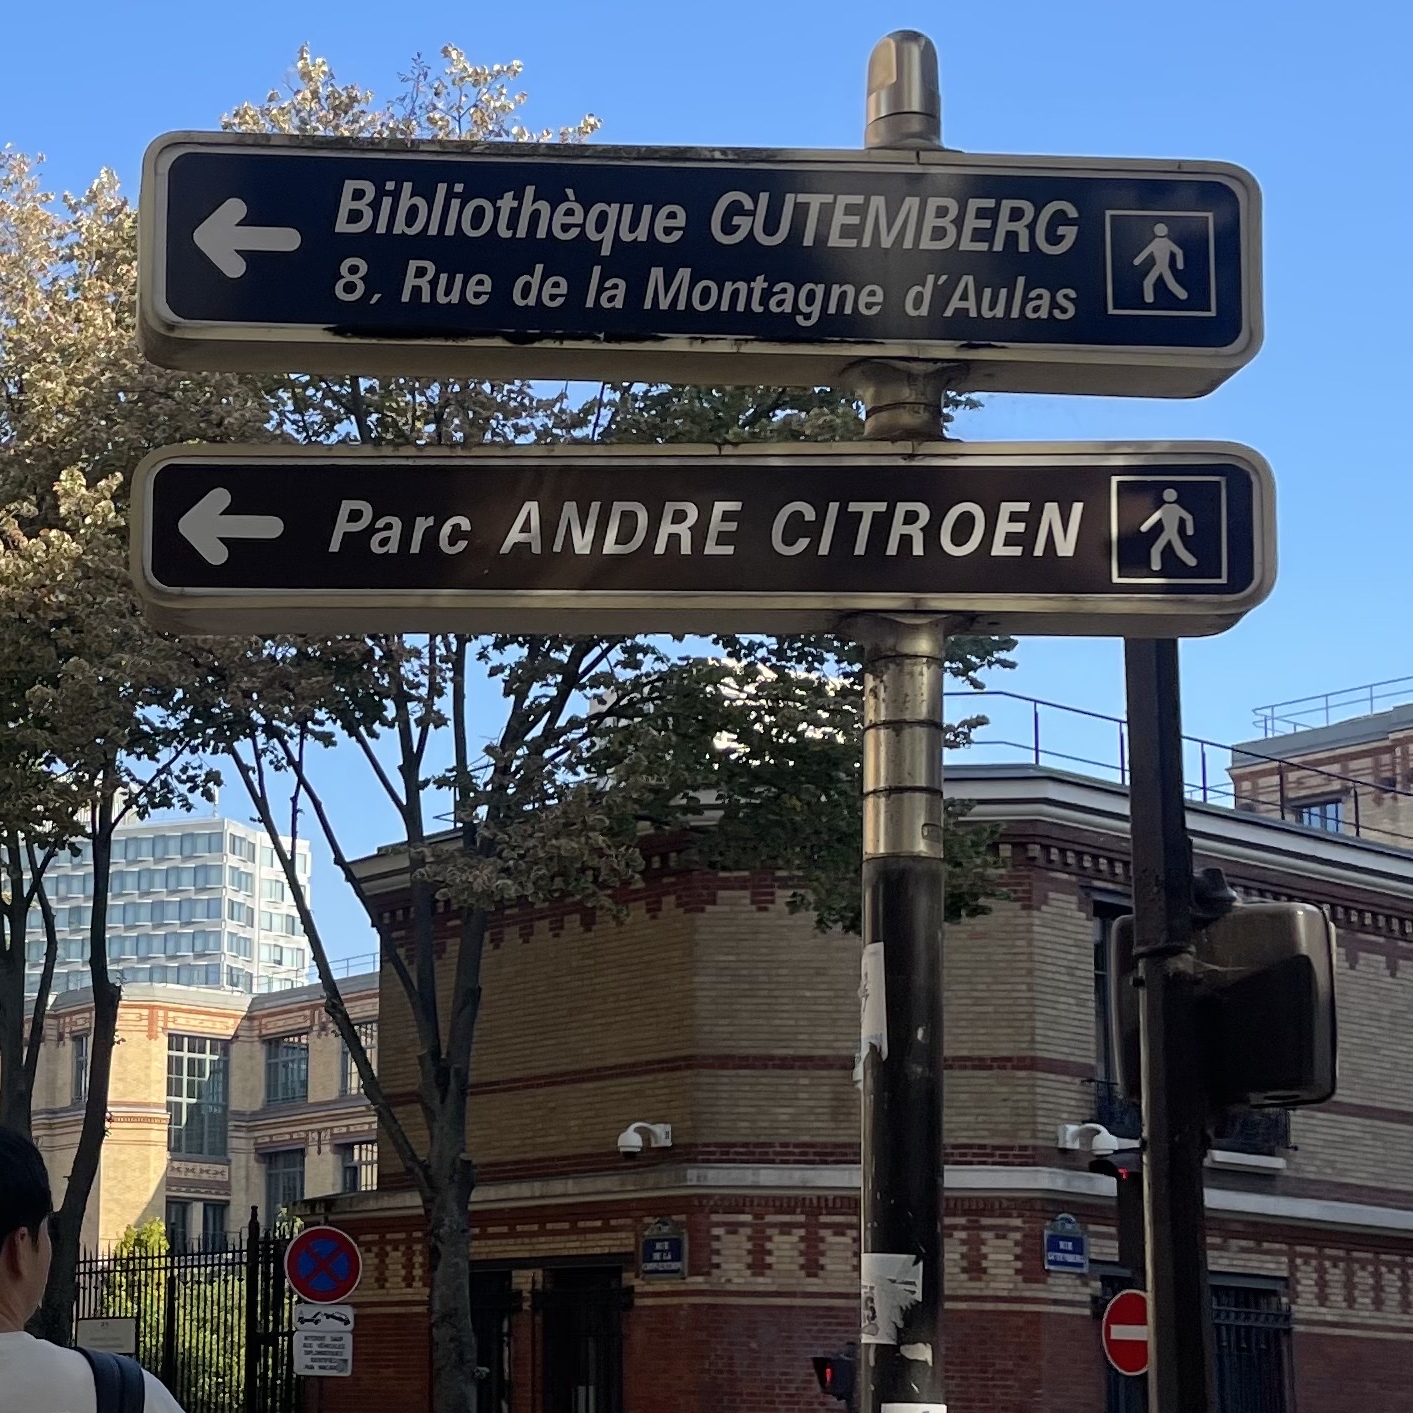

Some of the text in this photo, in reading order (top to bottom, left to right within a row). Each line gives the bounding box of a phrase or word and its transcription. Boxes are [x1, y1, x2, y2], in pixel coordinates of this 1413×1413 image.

[334, 180, 1079, 256] Bibliothèque GUTEMBERG
[335, 256, 383, 305] 8,
[401, 259, 493, 305] Rue
[512, 263, 569, 307] de
[585, 265, 626, 309] la
[644, 267, 884, 328] Montagne
[328, 500, 1085, 557] Parc ANDRE CITROEN
